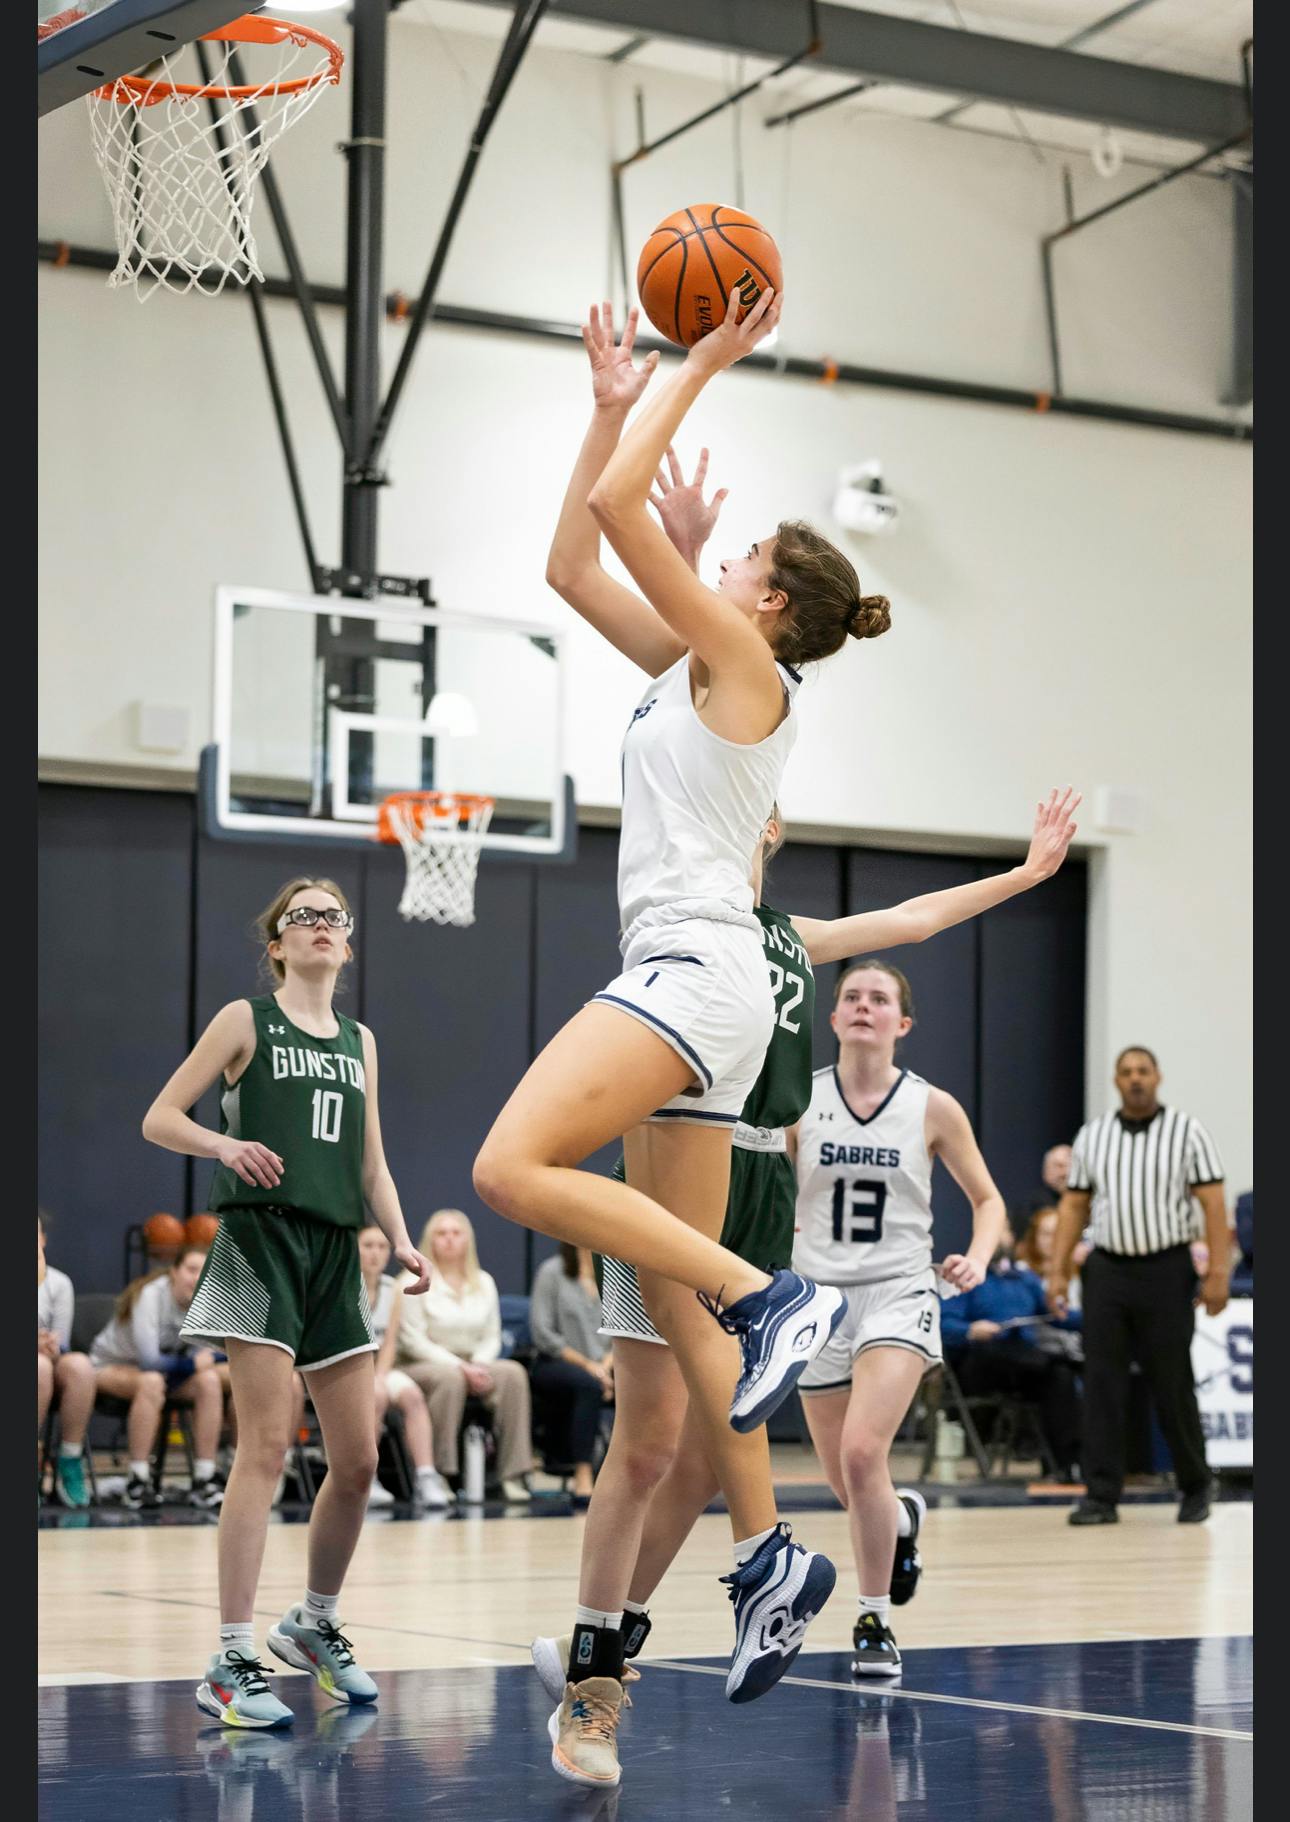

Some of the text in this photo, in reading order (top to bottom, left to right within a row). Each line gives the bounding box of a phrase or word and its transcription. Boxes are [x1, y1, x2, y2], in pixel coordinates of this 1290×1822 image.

[312, 1089, 344, 1143] 10
[820, 1142, 900, 1168] SABRES
[832, 1177, 888, 1243] 13
[918, 1310, 933, 1334] 13
[1227, 1325, 1254, 1394] S
[1199, 1412, 1254, 1440] SAB
